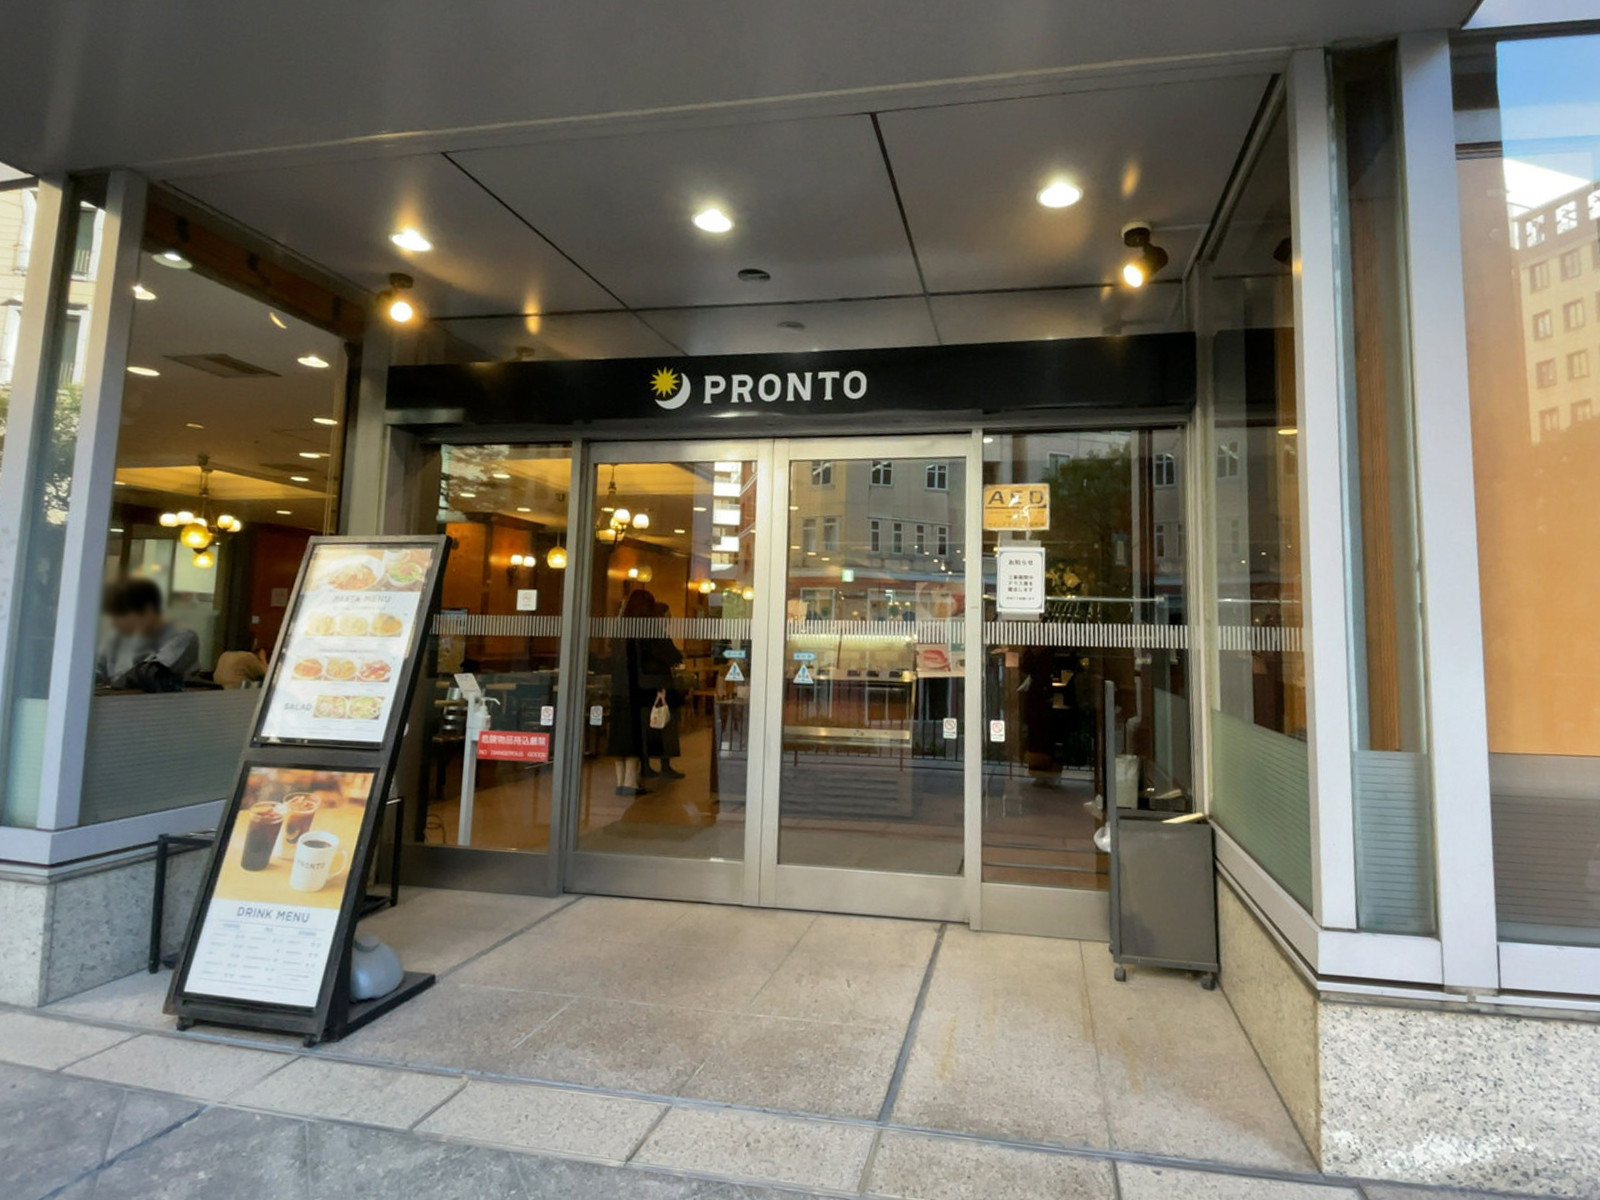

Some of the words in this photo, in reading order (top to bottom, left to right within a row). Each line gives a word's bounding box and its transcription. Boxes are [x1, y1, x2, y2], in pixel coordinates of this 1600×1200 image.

[703, 370, 868, 405] PRONTO
[988, 490, 1045, 504] AED
[283, 702, 313, 711] SALAD
[236, 907, 272, 920] DRINK
[275, 910, 311, 923] MENU
